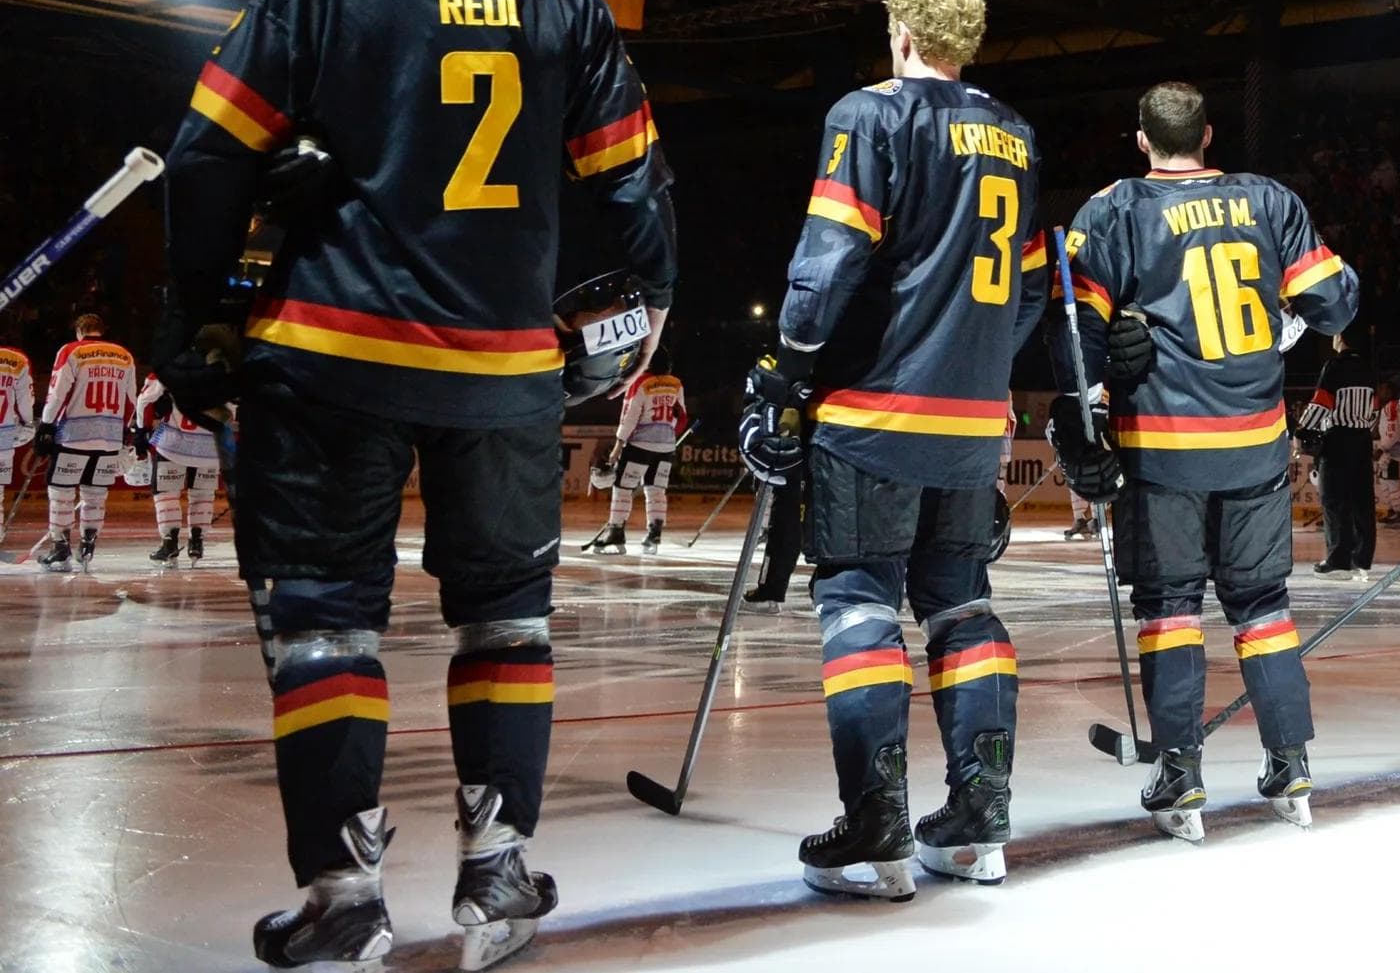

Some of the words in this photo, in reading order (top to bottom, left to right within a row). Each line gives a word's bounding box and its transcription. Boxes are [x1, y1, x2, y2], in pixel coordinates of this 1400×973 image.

[440, 51, 523, 212] 2
[826, 133, 849, 175] 3
[949, 123, 1029, 172] KRUEGER
[971, 175, 1020, 306] 3
[1163, 199, 1225, 236] WOLF
[1229, 197, 1257, 228] M.
[0, 253, 52, 310] AUER
[1182, 242, 1273, 361] 16
[85, 381, 120, 415] 44
